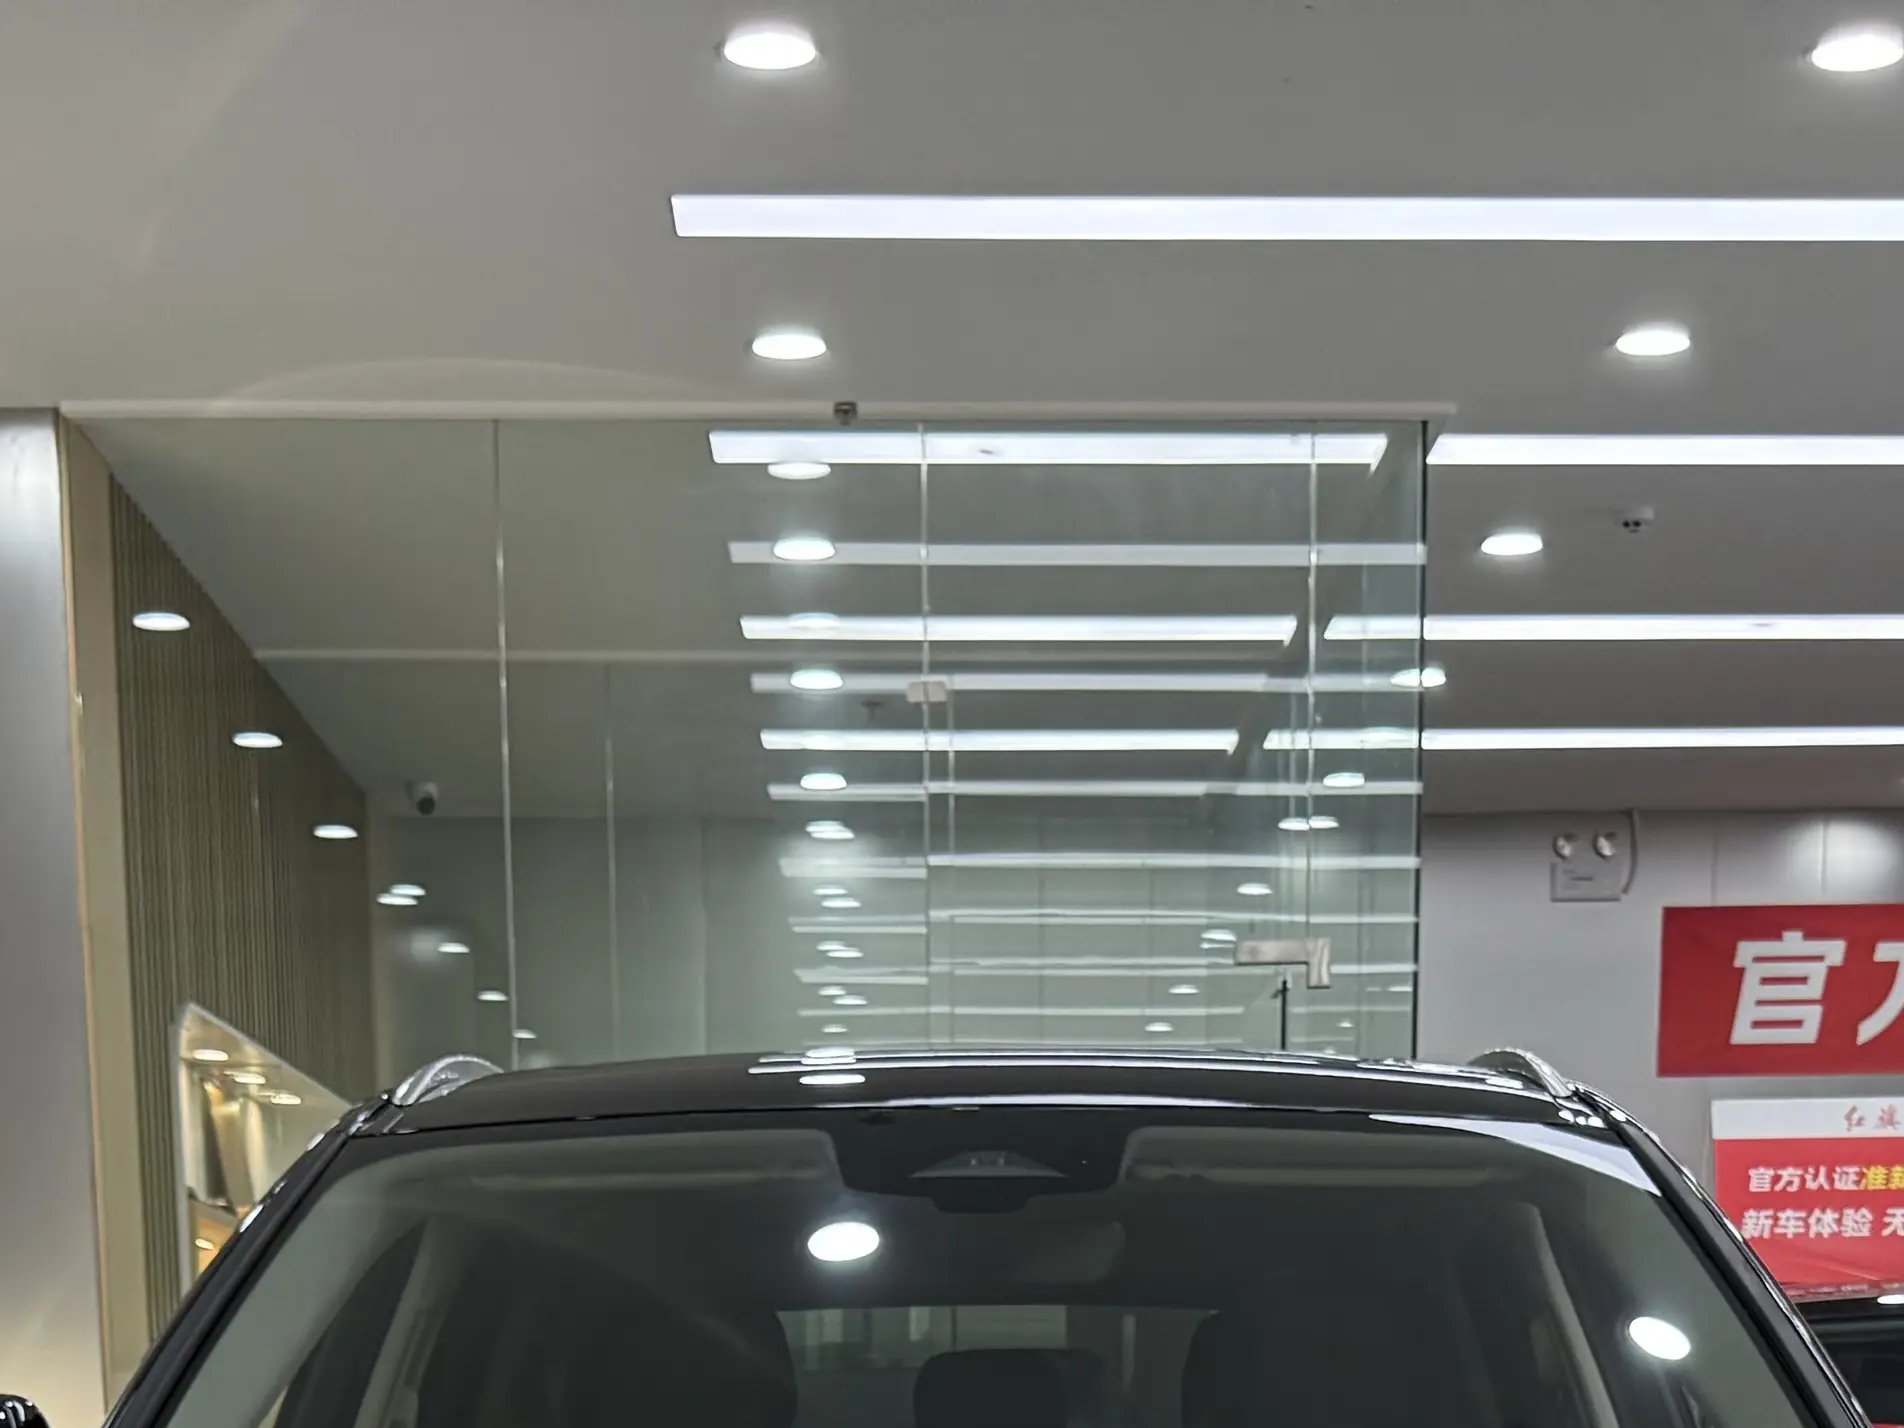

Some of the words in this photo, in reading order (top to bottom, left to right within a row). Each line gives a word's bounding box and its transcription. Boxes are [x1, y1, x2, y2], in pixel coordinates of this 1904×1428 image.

[1843, 1104, 1902, 1132] 红旗
[1742, 1206, 1874, 1240] 新车体验
